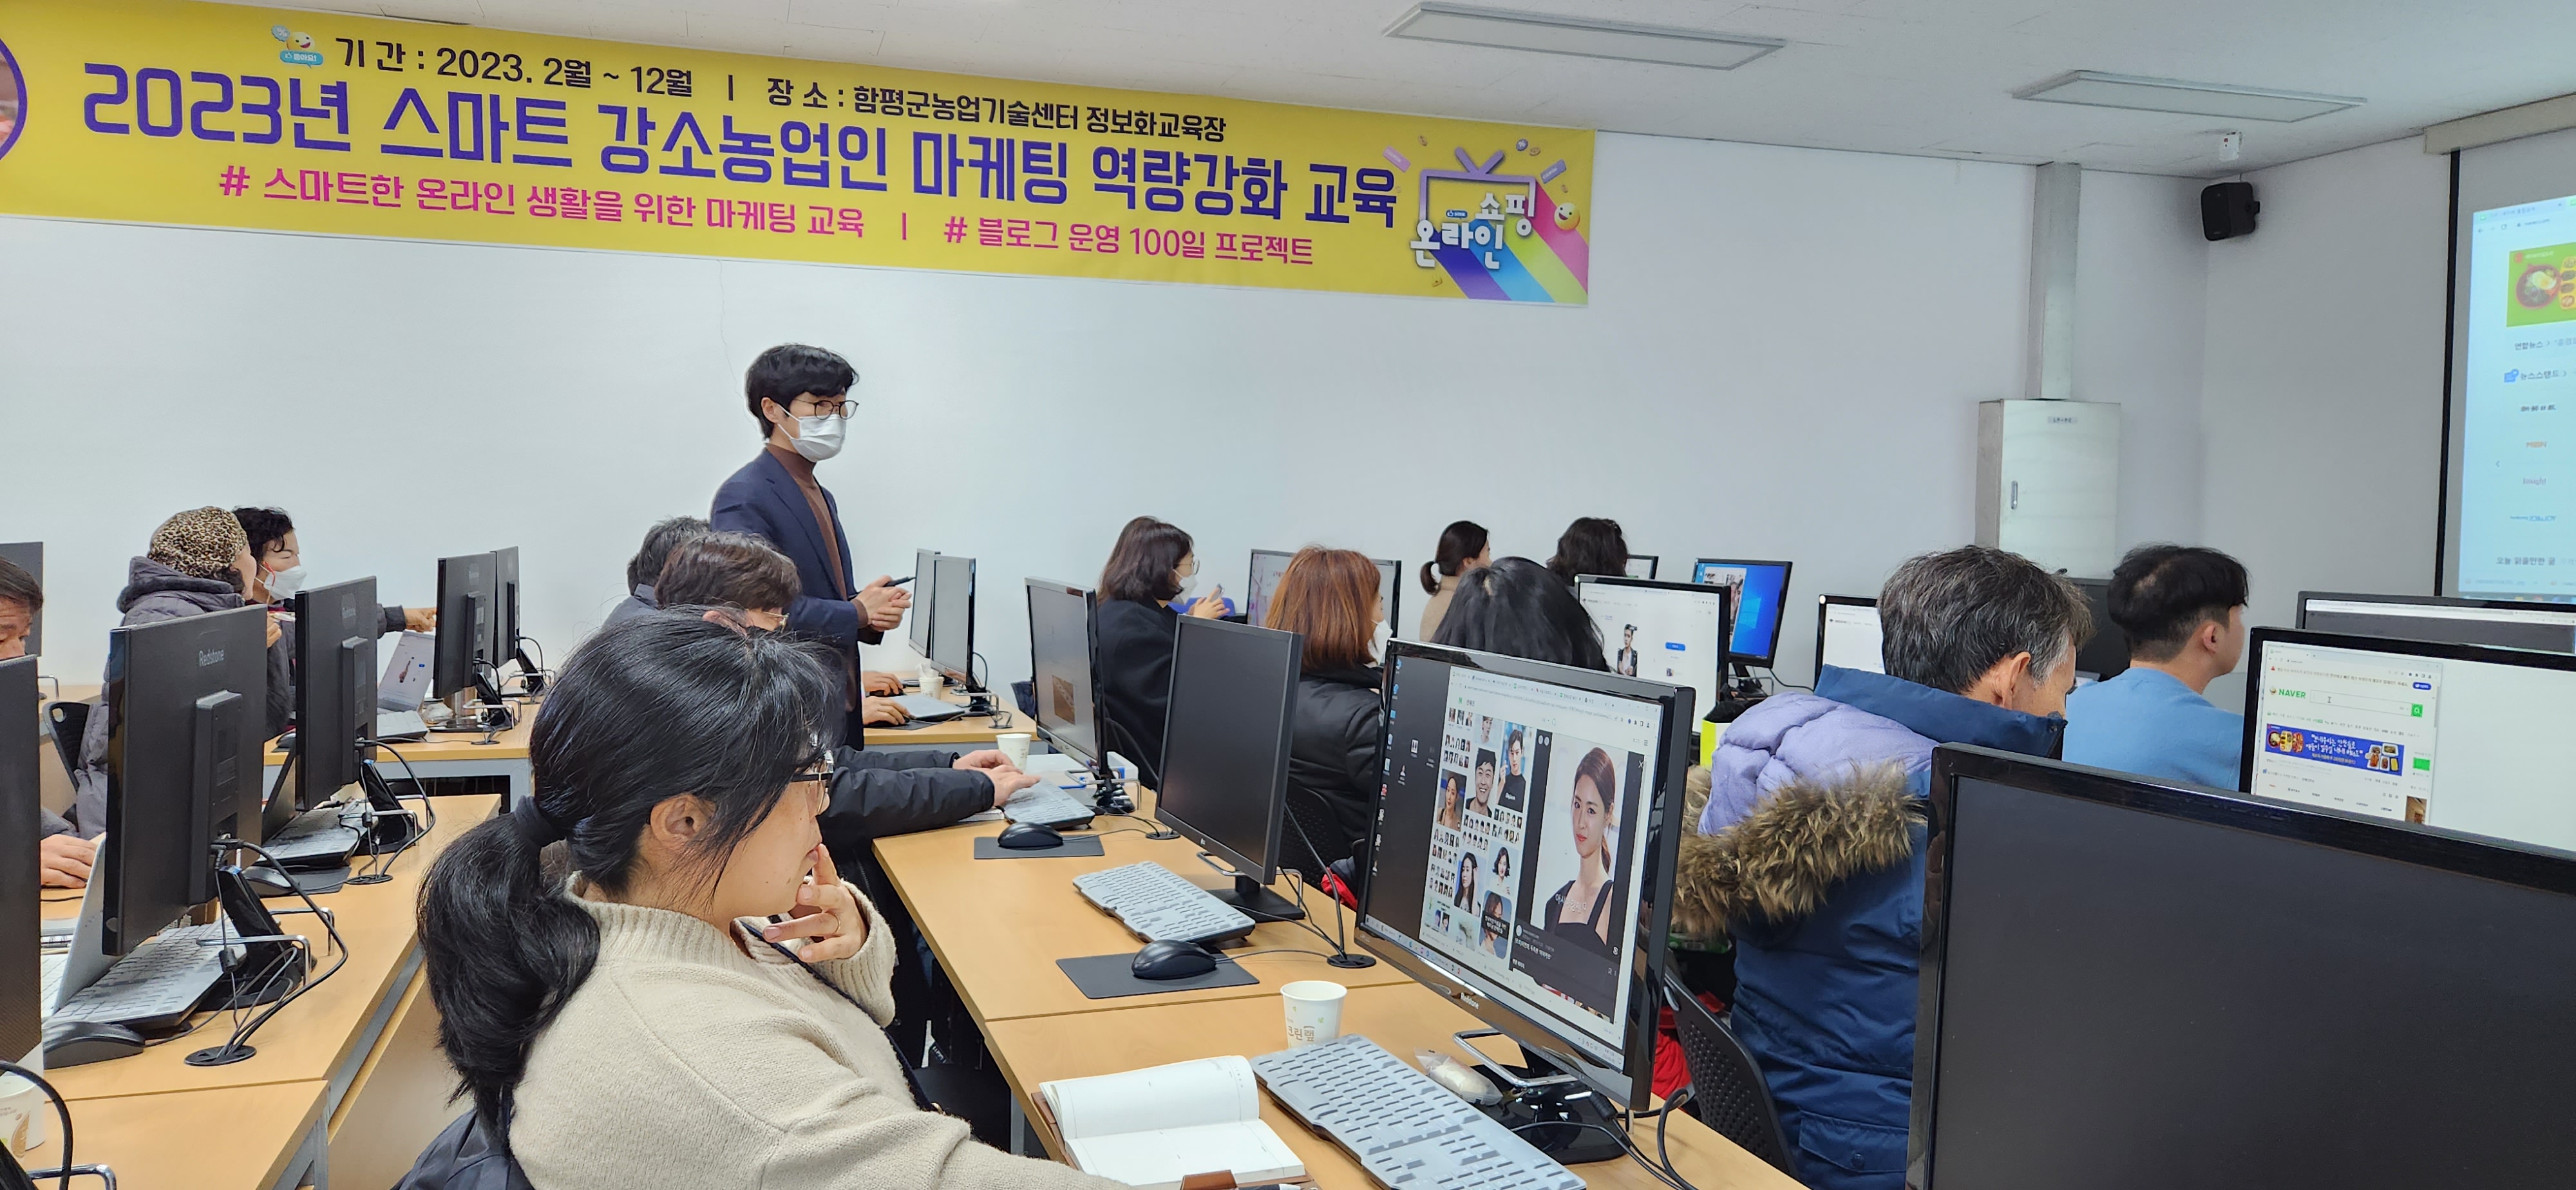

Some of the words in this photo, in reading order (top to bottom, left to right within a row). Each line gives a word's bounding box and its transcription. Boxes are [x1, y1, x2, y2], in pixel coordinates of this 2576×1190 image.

[336, 37, 365, 68] 기
[375, 41, 406, 72] 간
[437, 48, 532, 83] 2023.
[543, 57, 591, 89] 2월
[630, 66, 692, 97] 12월
[767, 78, 794, 106] 장
[802, 82, 828, 109] 소
[853, 86, 1078, 130] 함평군농업기술센터
[1086, 106, 1227, 142] 정보화교육장
[84, 63, 352, 152] 2023년
[380, 88, 573, 167] 스마트
[597, 104, 888, 192] 강소농업인
[912, 131, 1068, 205] 마케팅
[1092, 146, 1289, 220] 역량강화
[1305, 164, 1397, 228] 교육
[263, 167, 406, 208] 스마트한
[415, 178, 516, 215] 온라인
[526, 185, 624, 222] 생활을
[632, 193, 697, 227] 위한
[705, 198, 797, 234] 마케팅
[807, 205, 865, 238] 교육
[1475, 193, 1535, 236] 쇼핑
[978, 218, 1059, 249] 블로그
[1068, 223, 1121, 254] 운영
[1130, 227, 1206, 259] 100일
[1215, 232, 1312, 264] 프로젝트
[1410, 219, 1504, 270] 온라인
[2514, 341, 2543, 351] 연합뉴스
[2521, 370, 2559, 381] 뉴스스탠드
[199, 649, 224, 667] Redstone
[2278, 688, 2307, 699] NAVER
[1461, 992, 1480, 1010] Redstone
